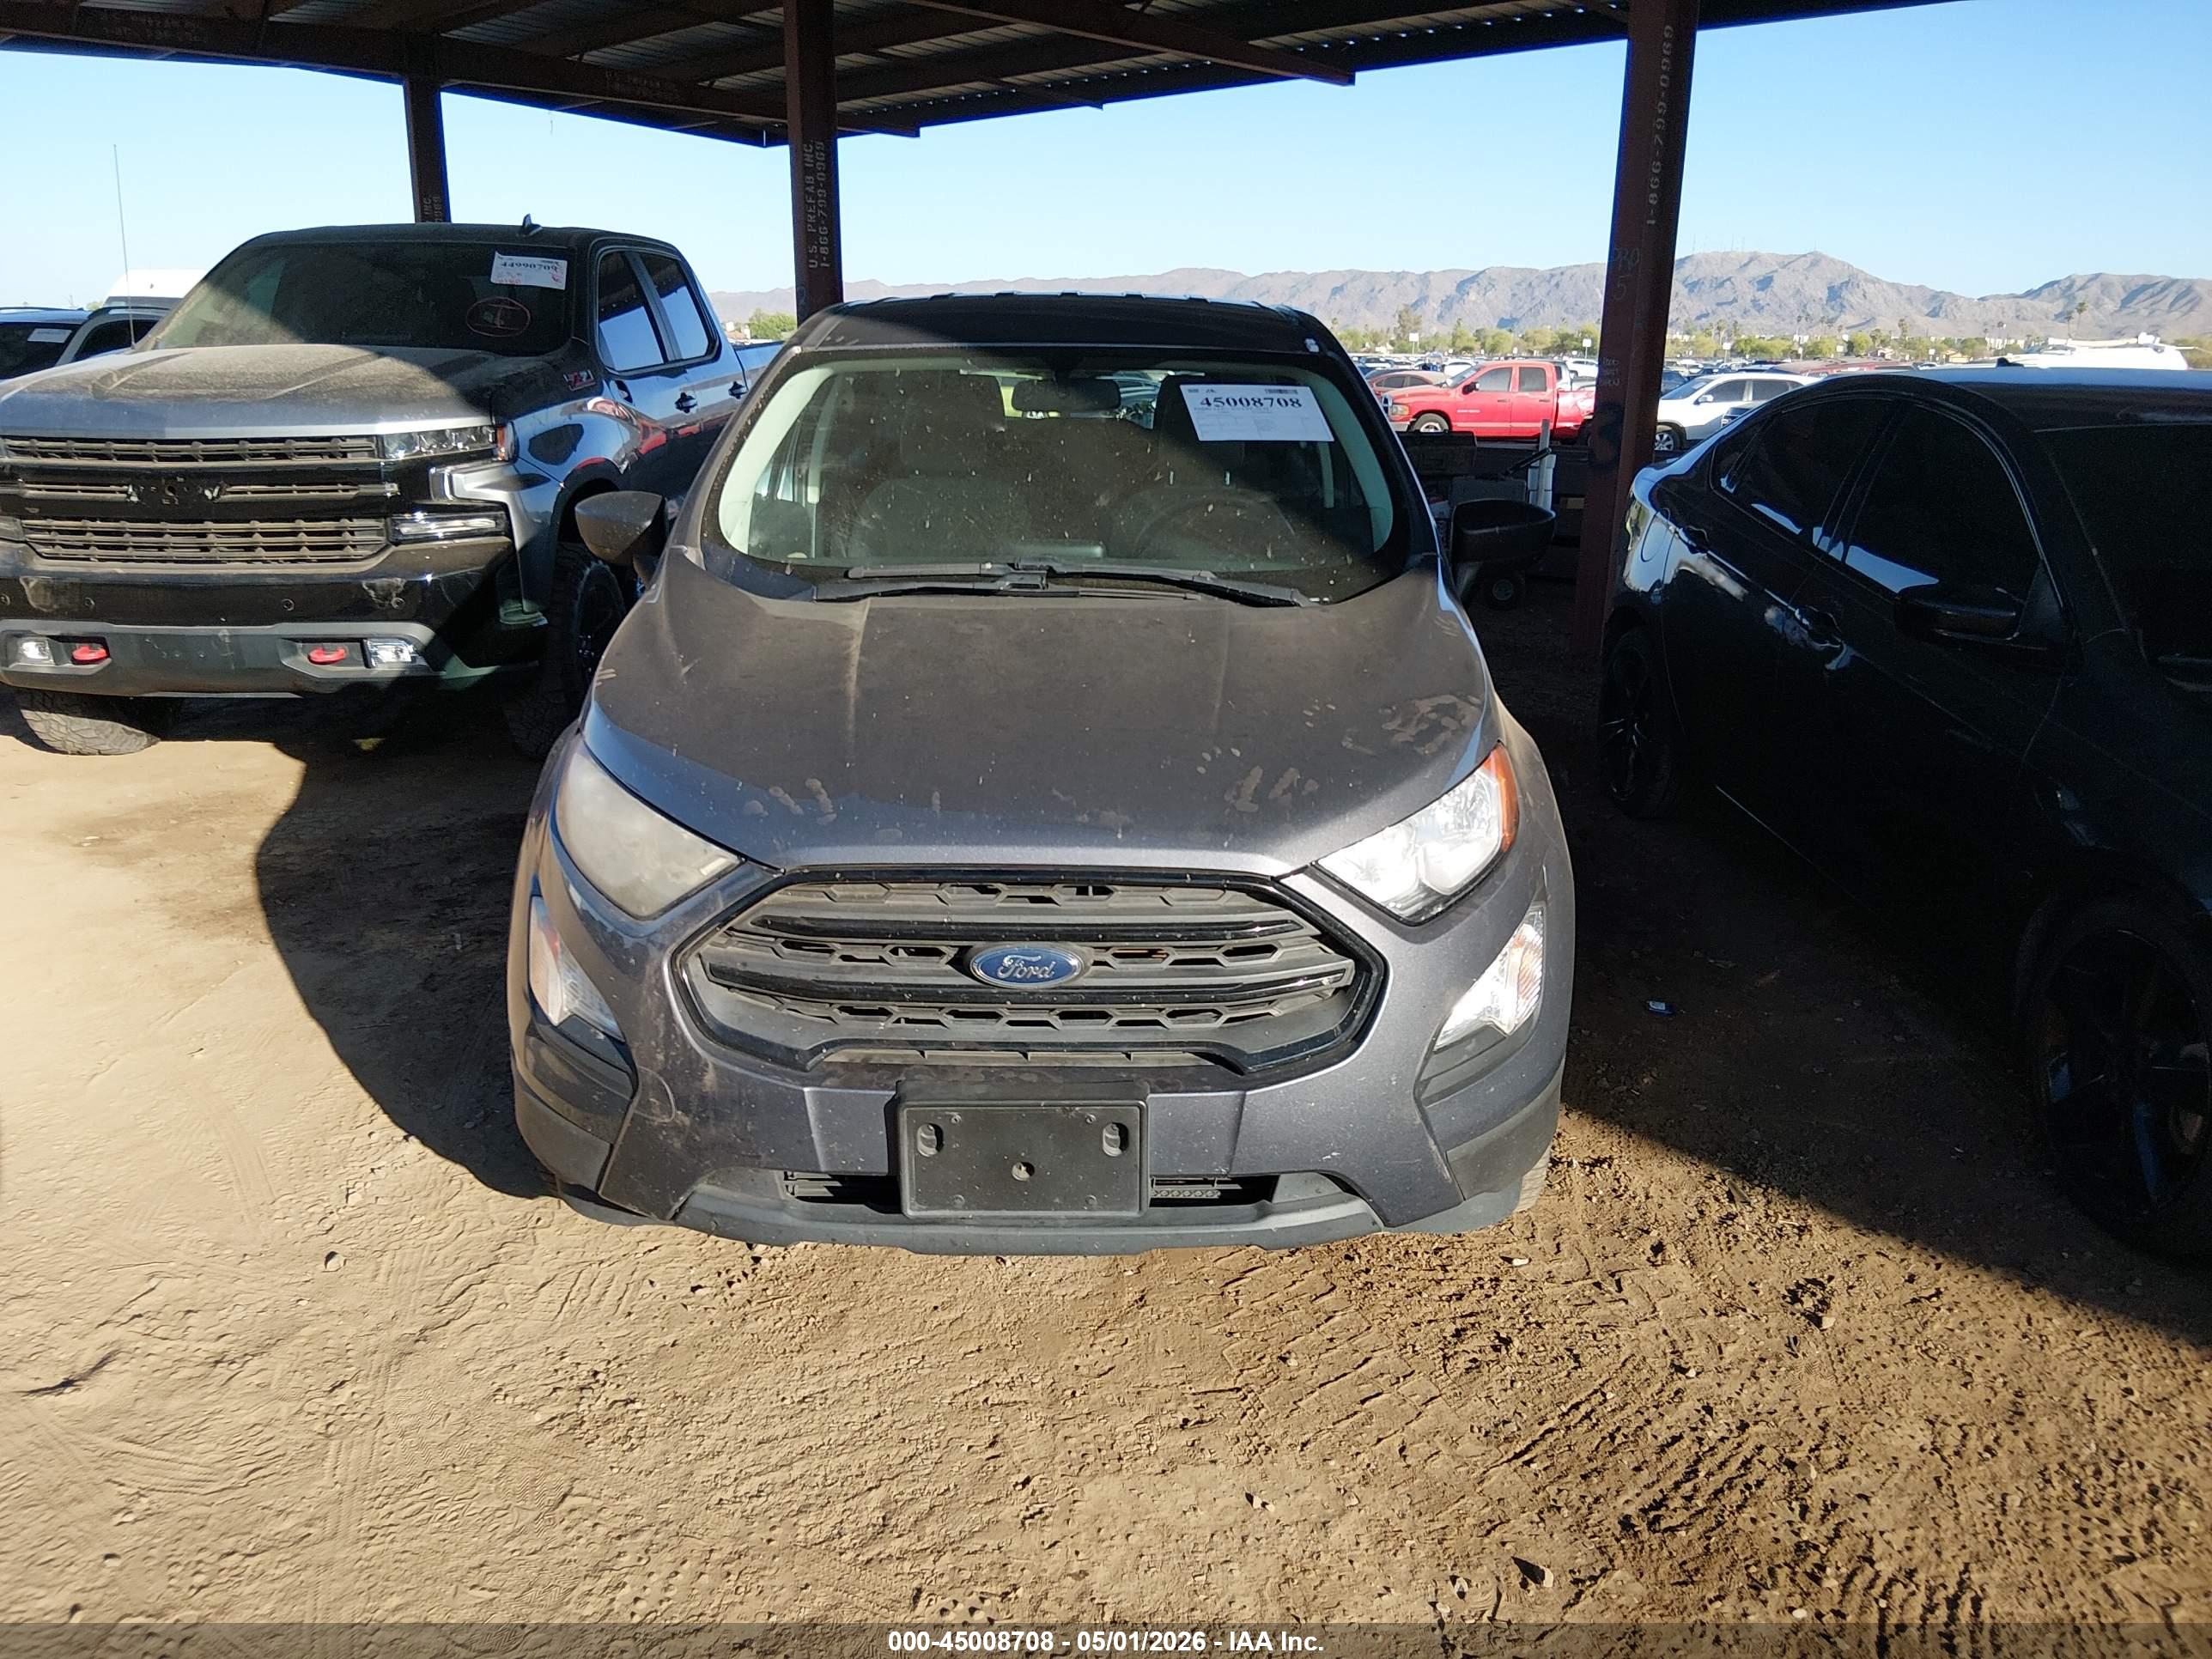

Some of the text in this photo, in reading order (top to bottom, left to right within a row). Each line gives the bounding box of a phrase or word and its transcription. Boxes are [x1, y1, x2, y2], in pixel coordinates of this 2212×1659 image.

[1645, 23, 1674, 227] 1-866-799-0969
[803, 138, 818, 269] U.S. PREFAB INC.
[814, 140, 830, 269] 1-866-799-0969
[1200, 396, 1304, 409] 45008708
[996, 953, 1056, 980] Ford
